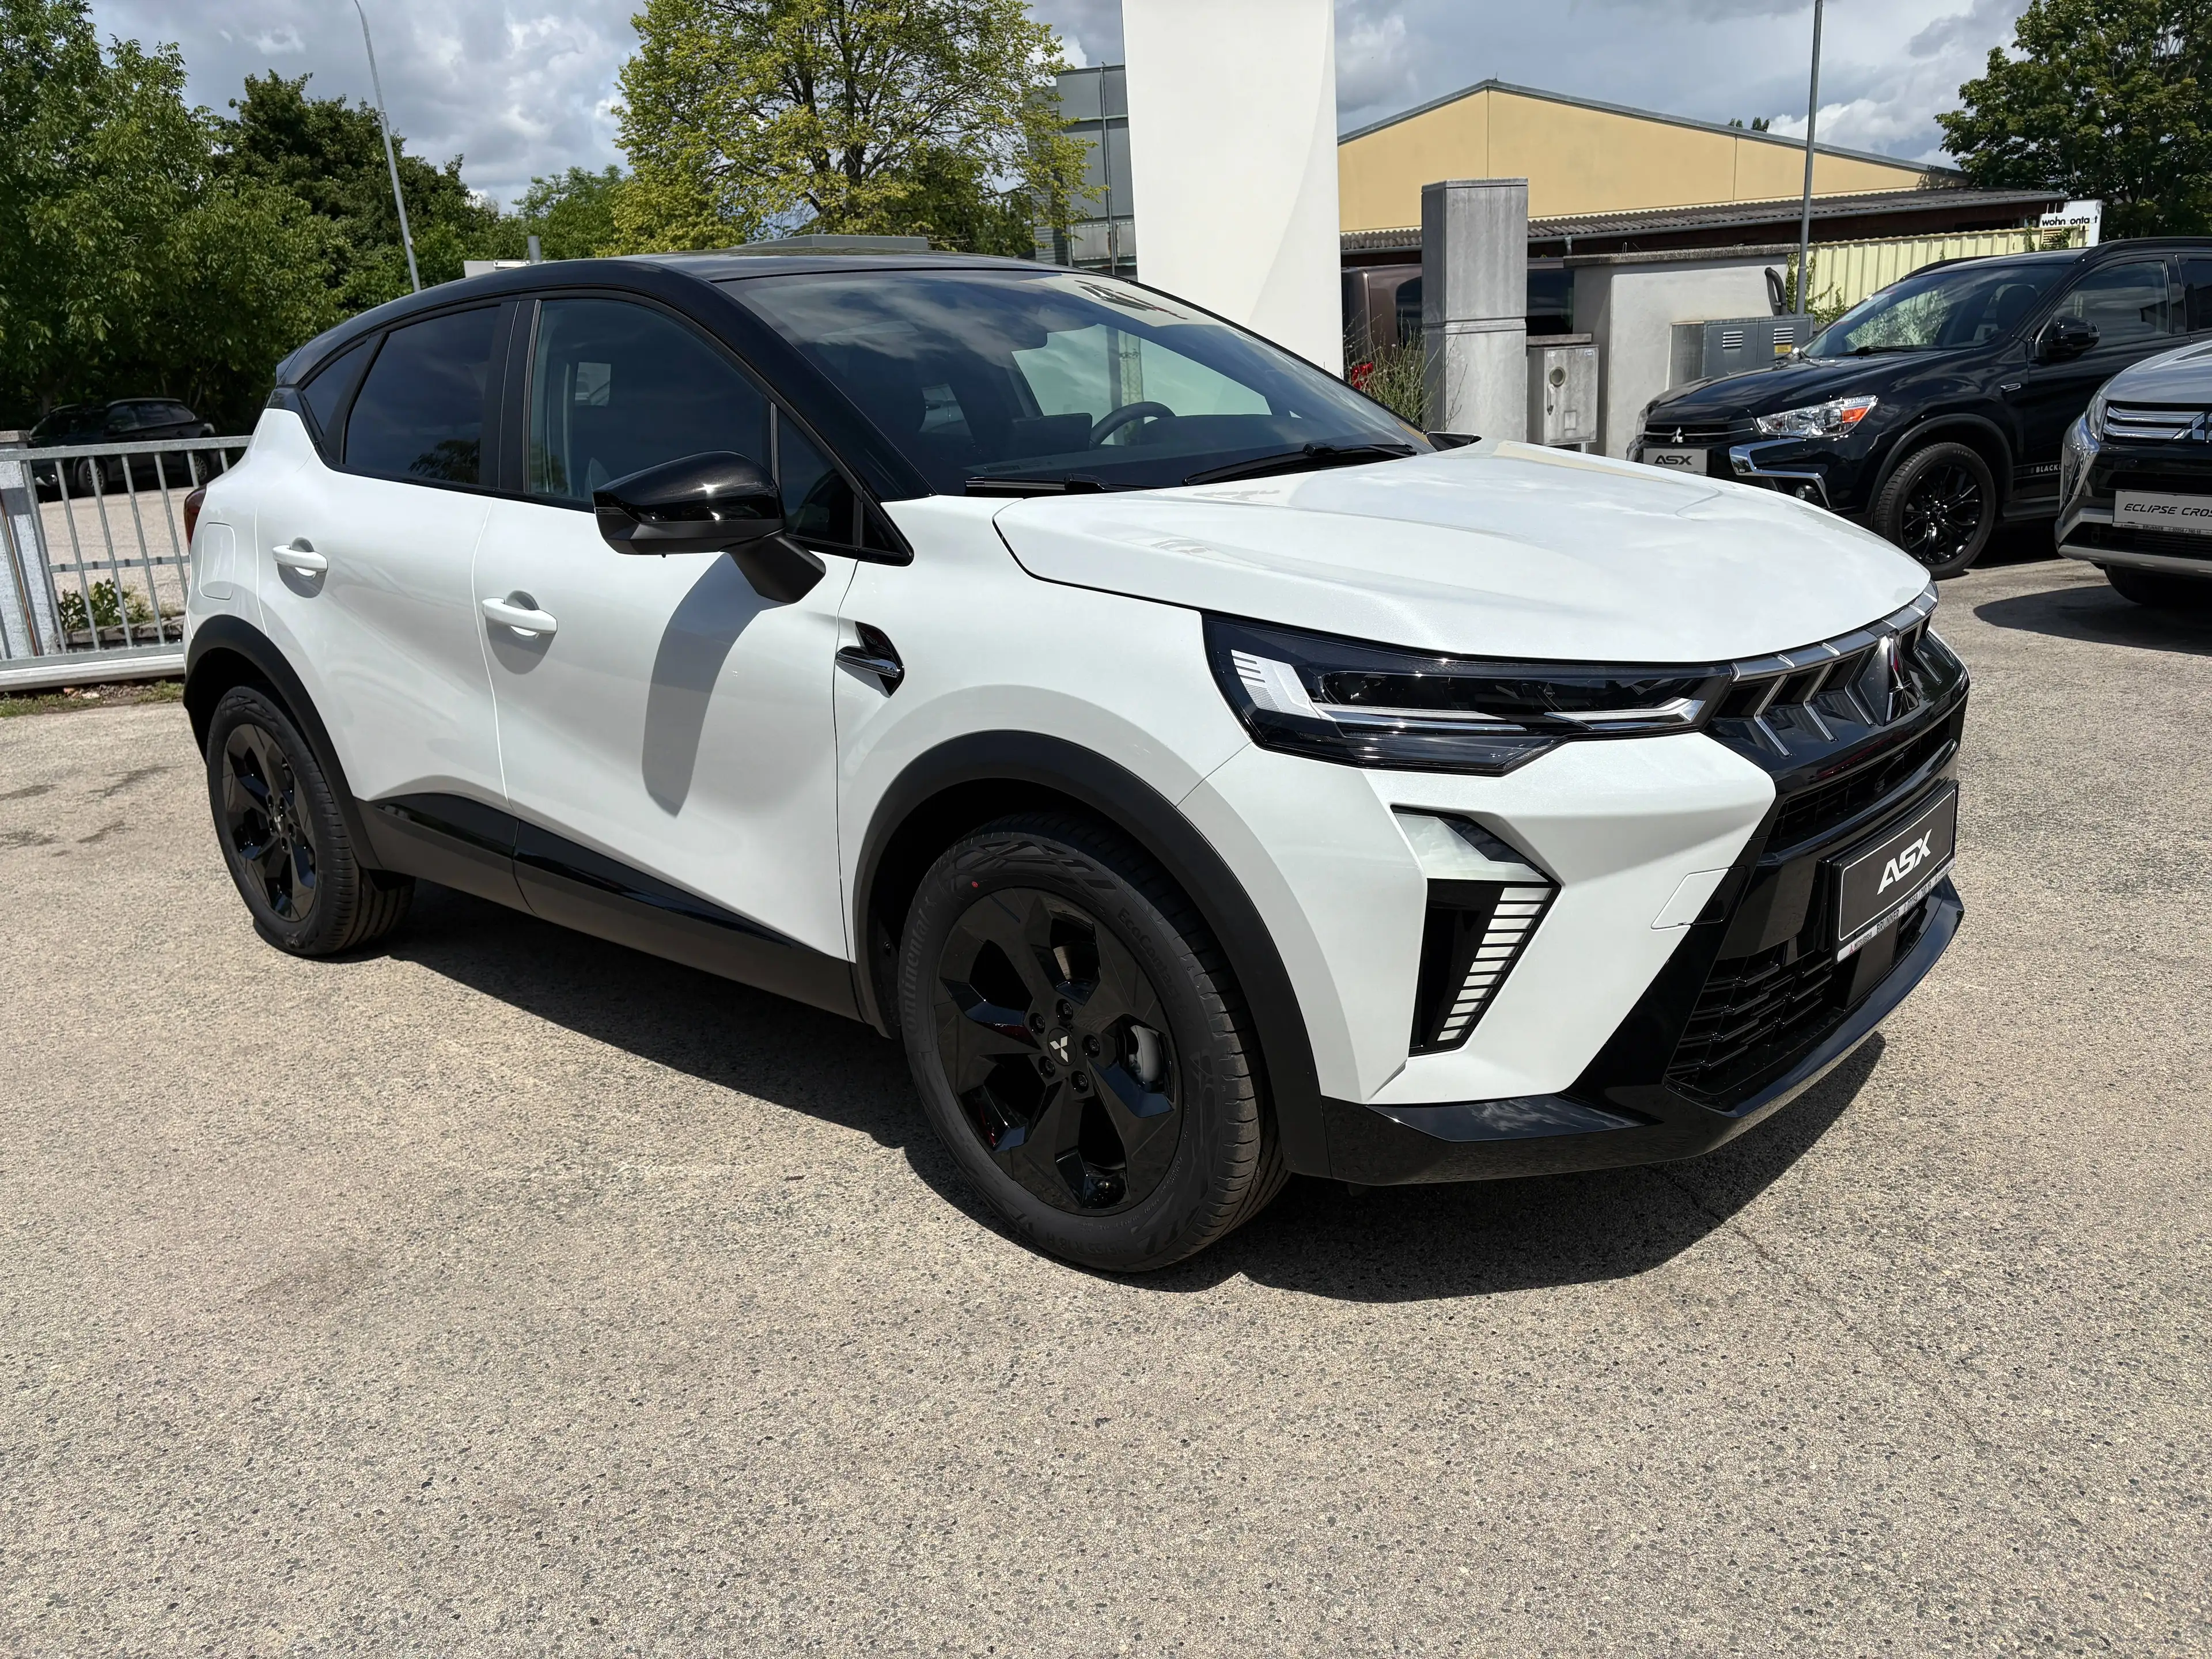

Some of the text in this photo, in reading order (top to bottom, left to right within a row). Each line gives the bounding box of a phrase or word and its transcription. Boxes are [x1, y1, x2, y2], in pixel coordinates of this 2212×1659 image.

[1654, 454, 1692, 465] ASX
[2124, 503, 2177, 514] ECLIPSE
[1877, 828, 1932, 895] ASX
[1876, 909, 1900, 934] BRUNNER
